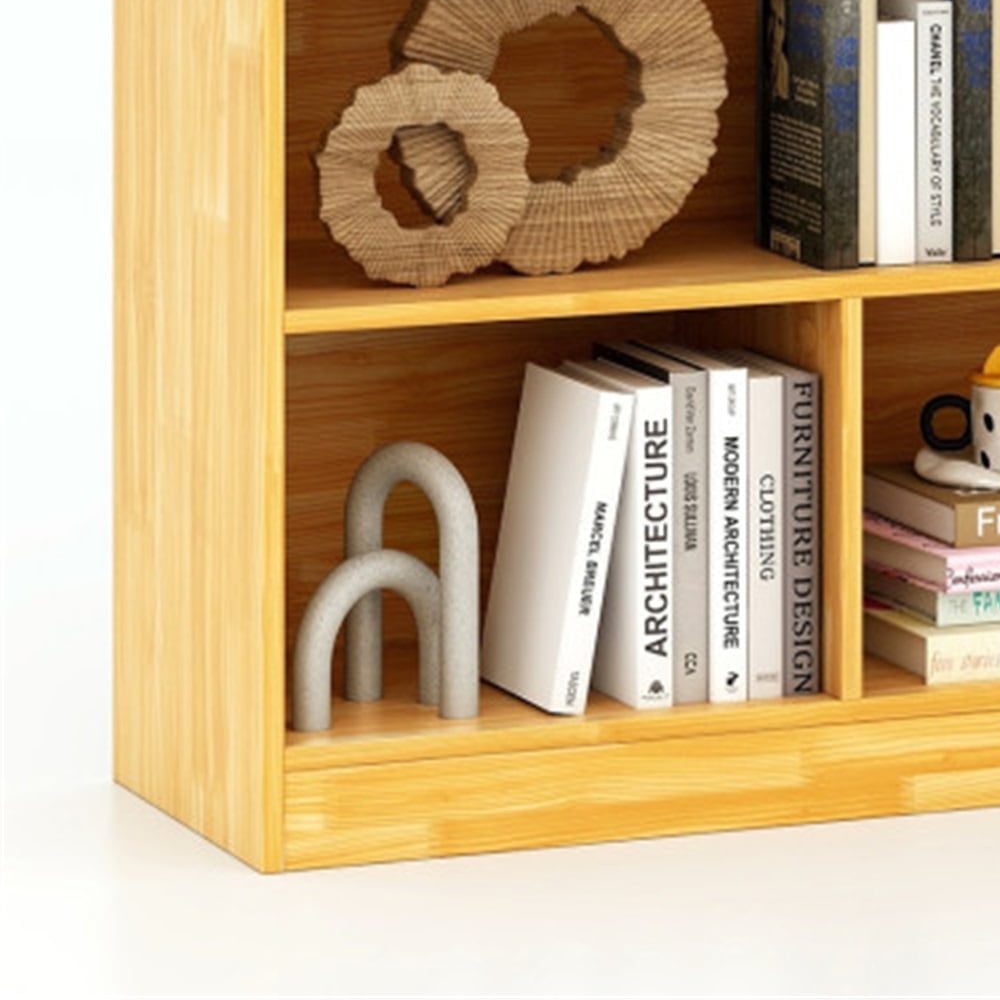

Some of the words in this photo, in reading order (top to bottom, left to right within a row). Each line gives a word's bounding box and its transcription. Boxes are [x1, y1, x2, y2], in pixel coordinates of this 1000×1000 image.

[930, 23, 943, 75] CHANEL
[723, 436, 740, 511] MODERN
[758, 474, 775, 582] CLOTHING
[793, 381, 813, 567] FURNITURE
[644, 418, 669, 657] ARCHITECTURE
[723, 515, 740, 650] ARCHITECTURE
[793, 576, 813, 694] DESIGN
